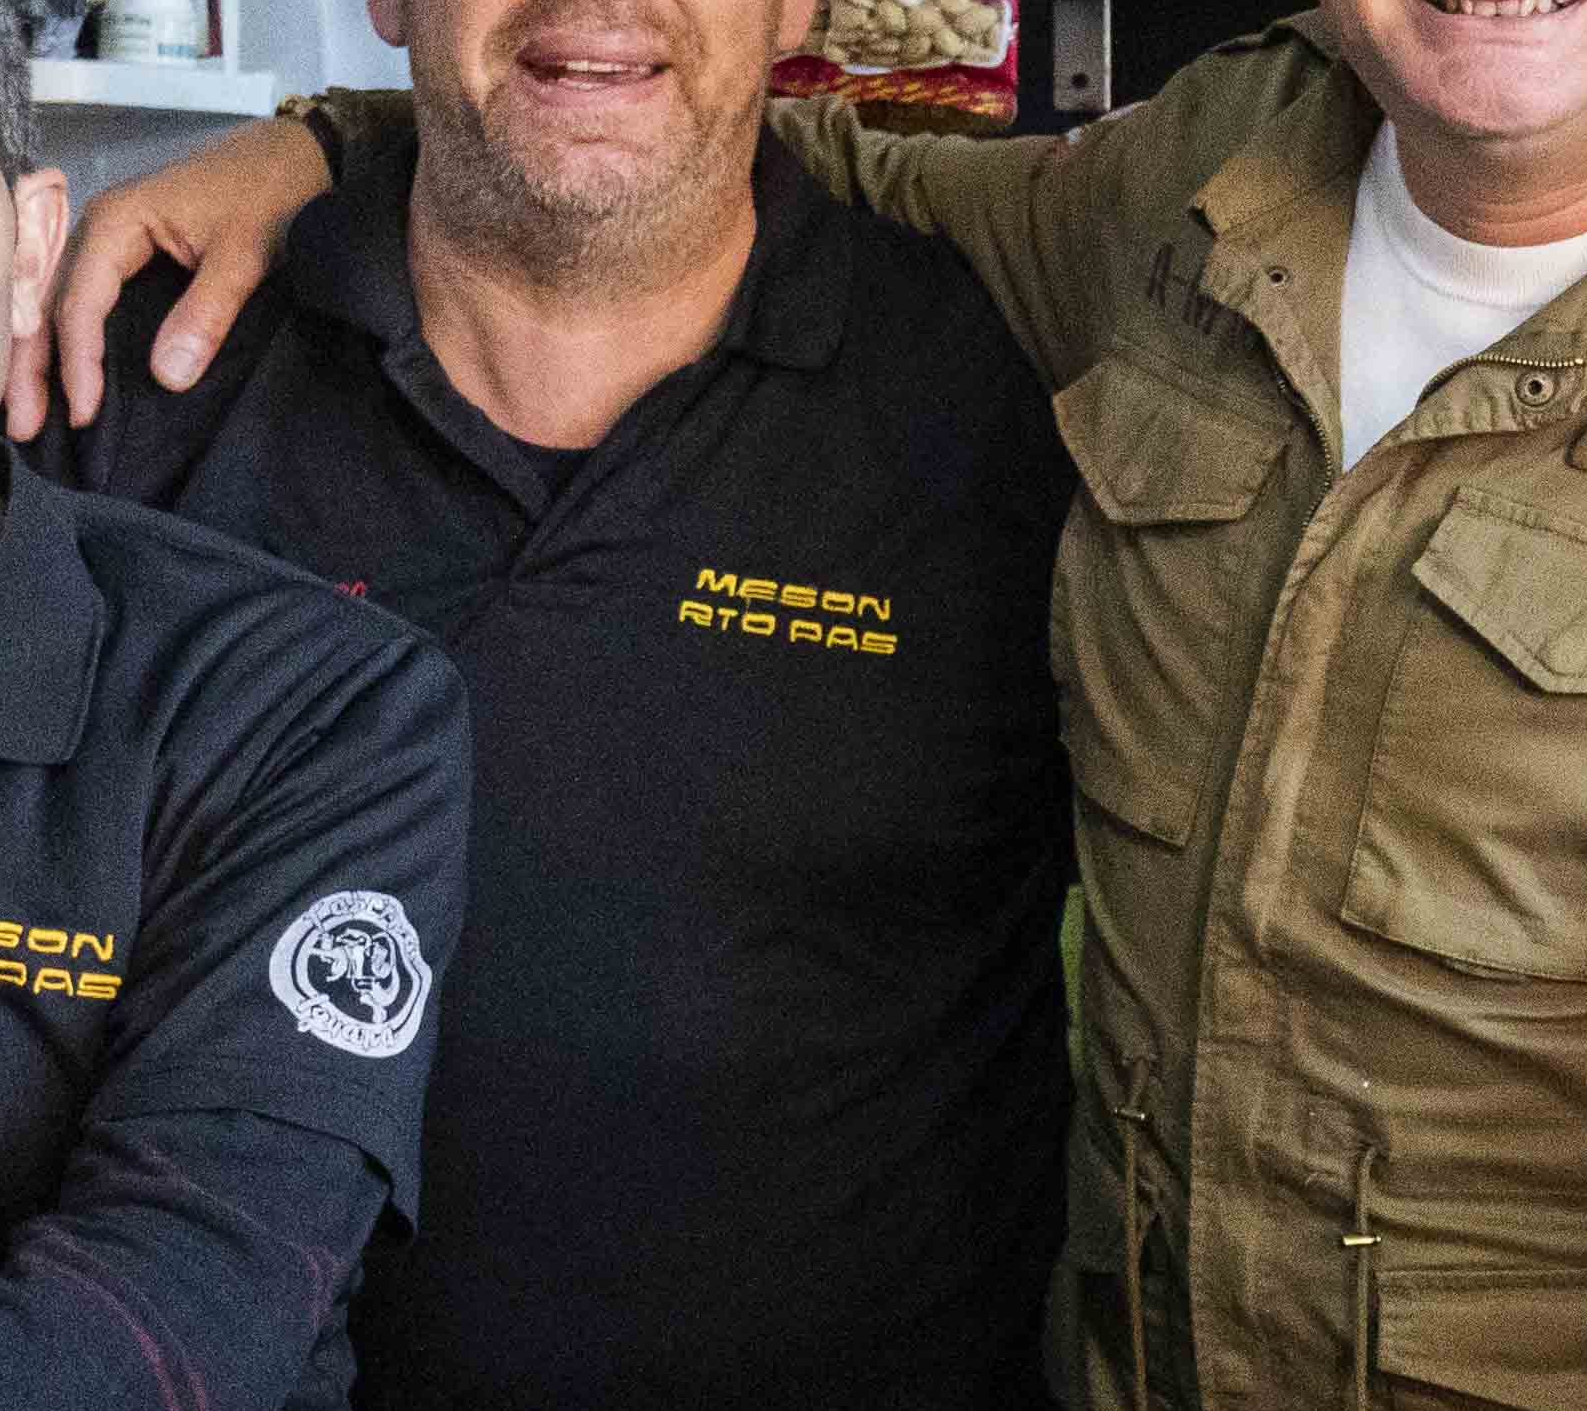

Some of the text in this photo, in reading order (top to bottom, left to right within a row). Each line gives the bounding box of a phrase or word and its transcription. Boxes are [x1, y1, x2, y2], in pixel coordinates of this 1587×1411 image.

[696, 567, 892, 622] MESON
[677, 598, 898, 655] RTO PAS
